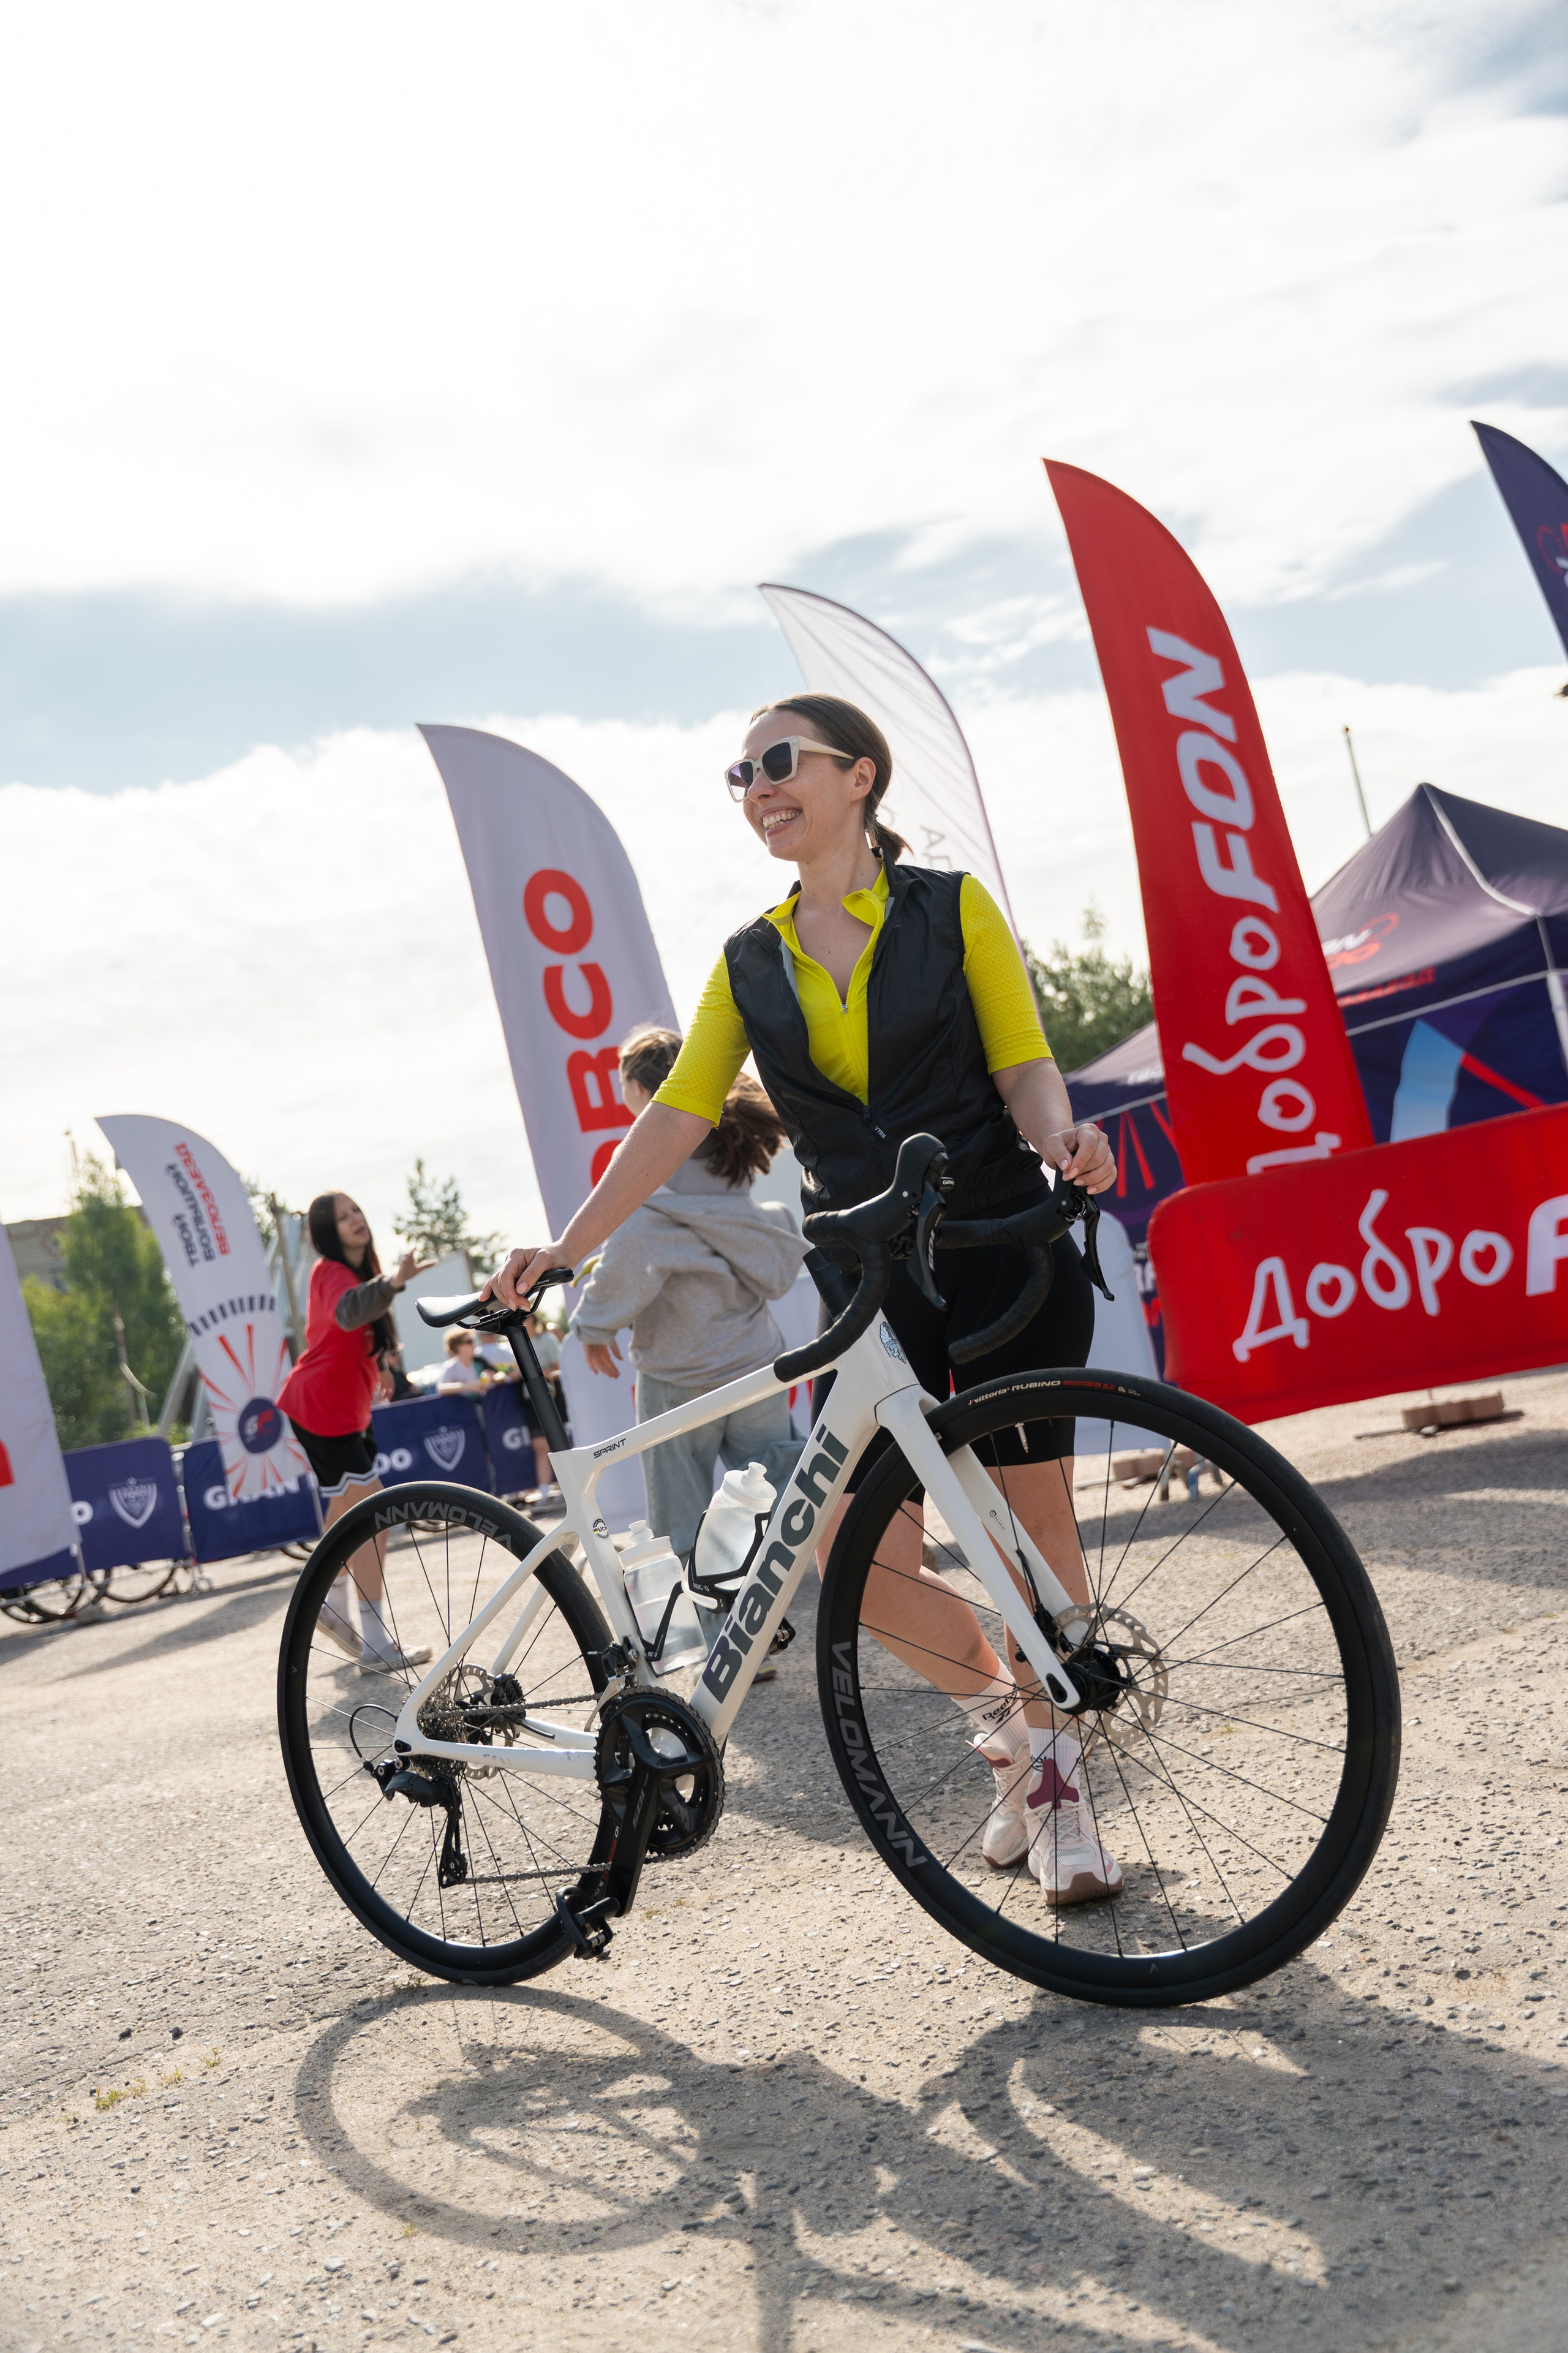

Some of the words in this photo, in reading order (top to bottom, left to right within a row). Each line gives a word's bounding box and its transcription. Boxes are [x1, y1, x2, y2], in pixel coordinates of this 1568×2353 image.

[522, 868, 638, 1189] RCO
[166, 1163, 215, 1261] БОЛЬШОЙ
[173, 1214, 200, 1266] ТВОЙ
[175, 1143, 230, 1255] ВЕЛОЗАЕЗД
[1012, 1380, 1061, 1391] RUBINO
[594, 1438, 626, 1459] SPRINT
[374, 1501, 512, 1551] VELOMANN
[703, 1424, 850, 1704] Bianchi
[831, 1641, 927, 1868] VELOMANN
